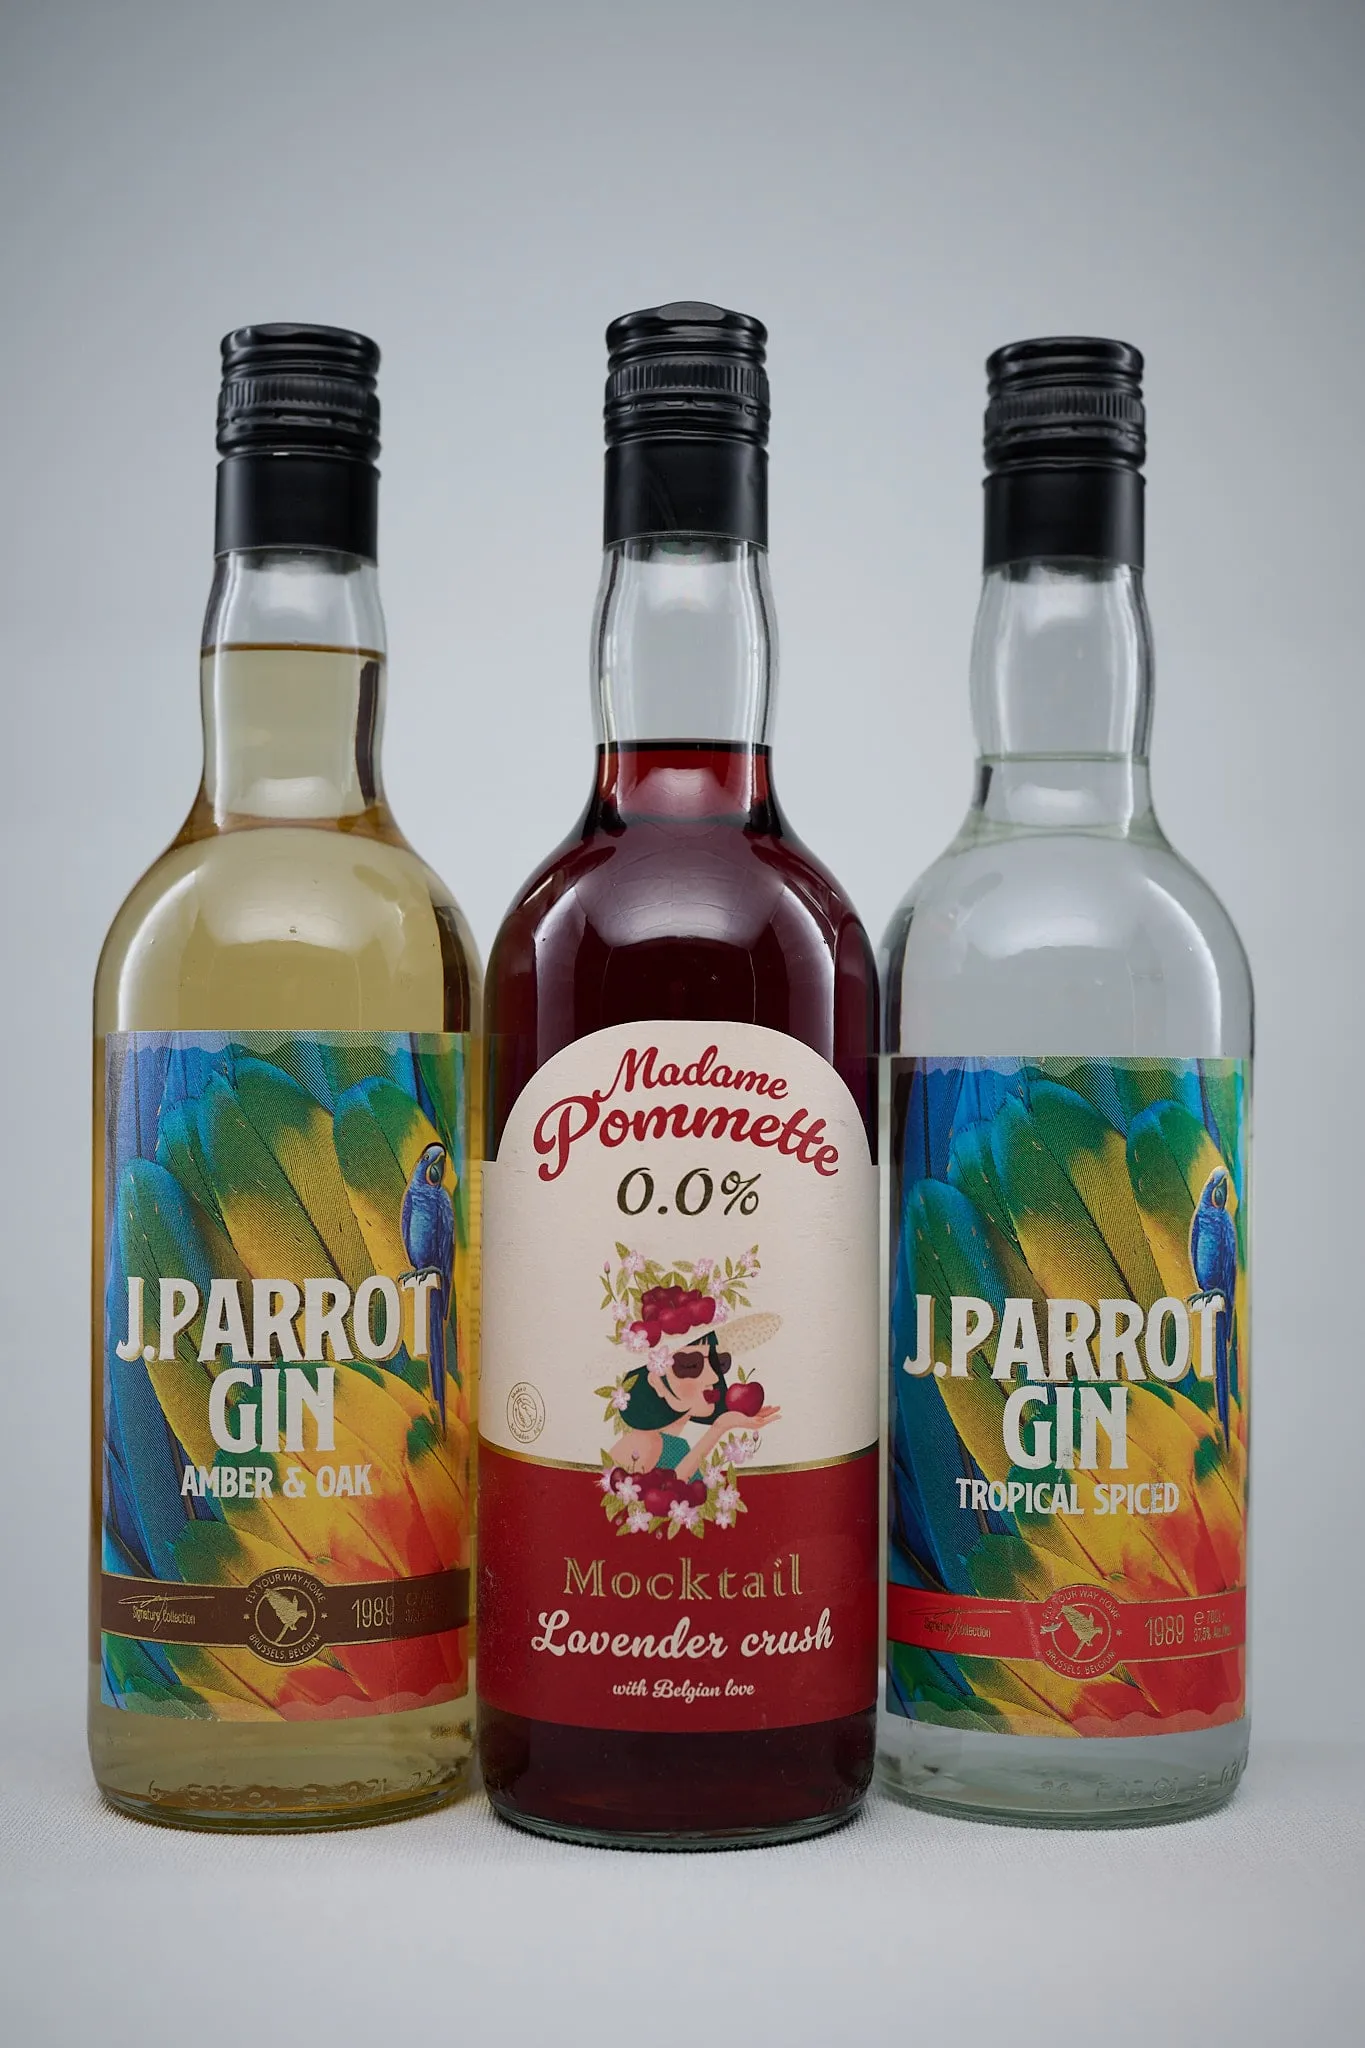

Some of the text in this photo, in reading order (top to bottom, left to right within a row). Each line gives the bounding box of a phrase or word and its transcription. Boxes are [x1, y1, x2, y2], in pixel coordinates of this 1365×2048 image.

[597, 1045, 789, 1101] Madame
[532, 1095, 840, 1182] Pommette
[616, 1167, 762, 1216] 0.0%
[115, 1273, 439, 1362] J.PARROT
[902, 1293, 1225, 1382] J.PARROT
[208, 1367, 336, 1454] GIN
[1002, 1385, 1129, 1470] GIN
[180, 1464, 373, 1499] AMBER & OAK
[955, 1478, 1180, 1516] TROPICAL SPICED
[245, 1573, 326, 1604] FLY YOUR WAY HOME
[562, 1553, 804, 1601] Mocktail
[1080, 1589, 1099, 1600] WAY
[351, 1595, 395, 1628] 1989
[530, 1607, 835, 1659] Lavender crush
[1144, 1614, 1185, 1647] 1989
[288, 1633, 321, 1659] BELGIUM
[612, 1679, 756, 1704] with Belgian love
